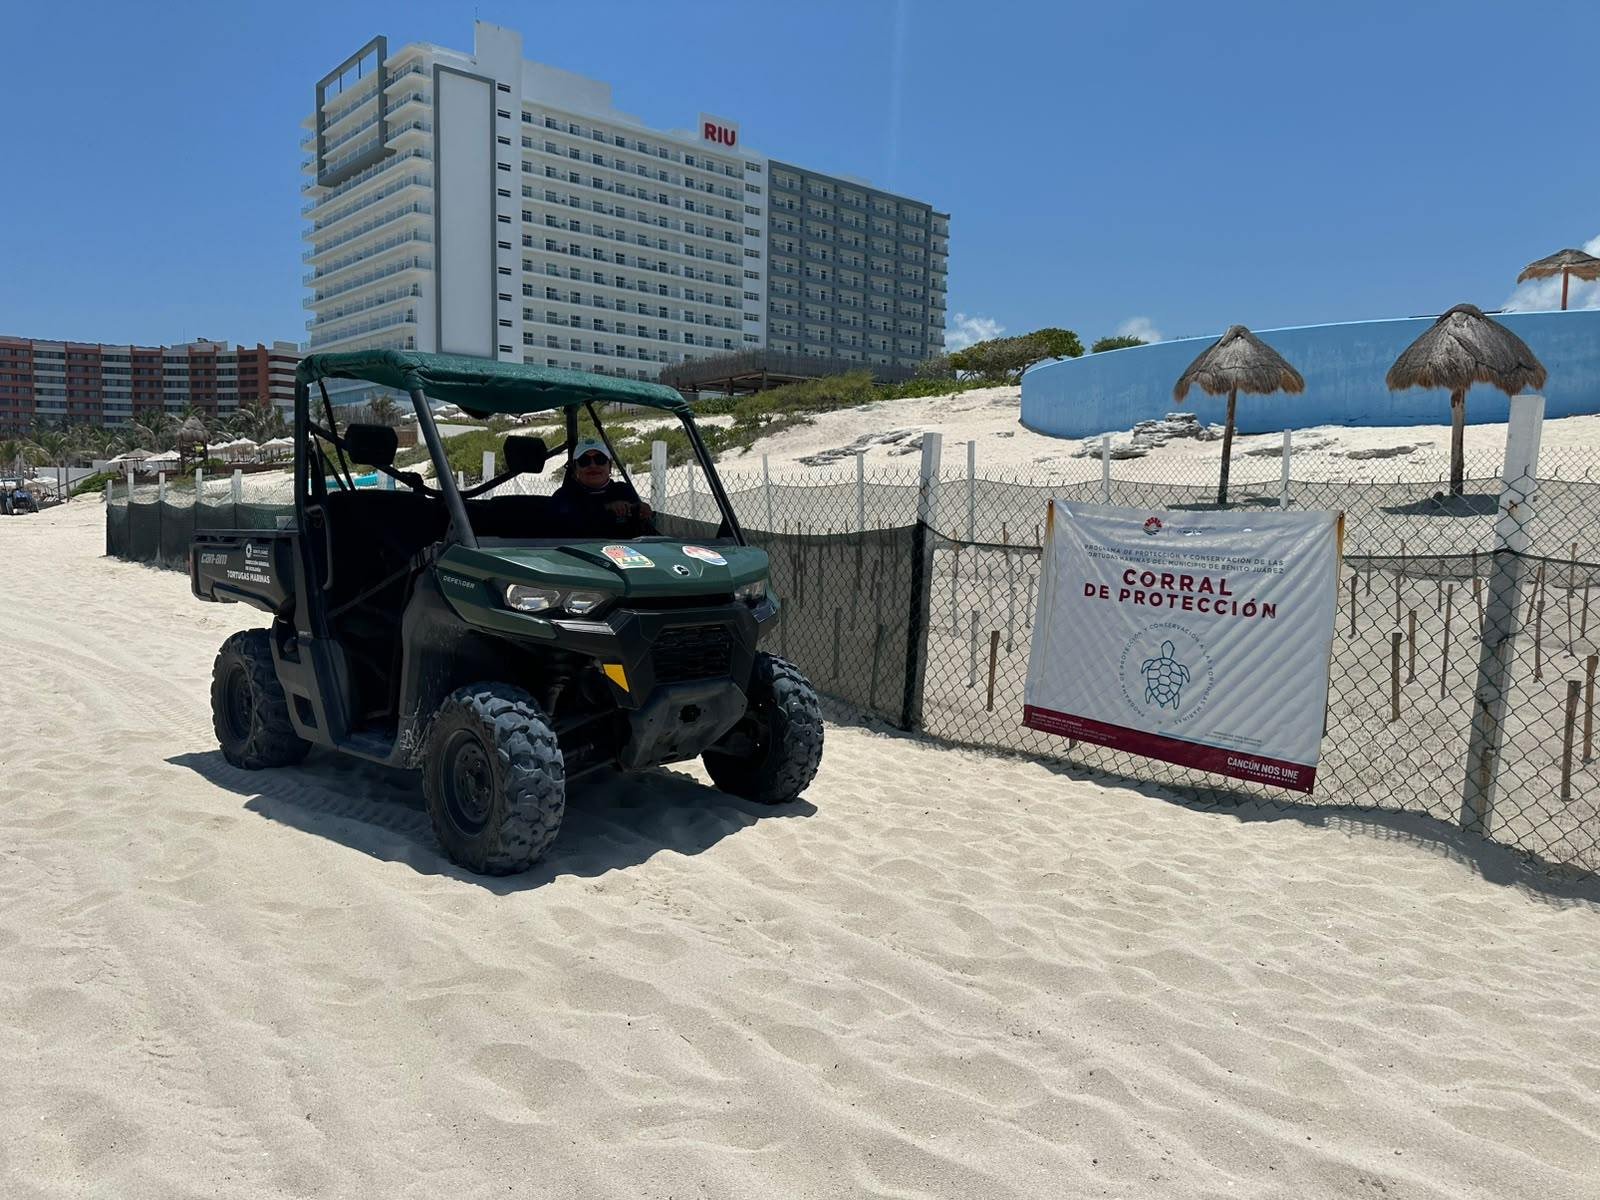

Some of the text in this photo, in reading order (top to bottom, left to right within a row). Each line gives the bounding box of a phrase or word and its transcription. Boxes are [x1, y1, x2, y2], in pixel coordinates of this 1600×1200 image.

[705, 122, 736, 146] RIU
[1087, 551, 1118, 560] ORTUGAS
[1168, 560, 1207, 569] MUNICIPIO
[1221, 564, 1250, 572] BENITO
[1190, 554, 1251, 564] CONSERVACIÓN
[226, 569, 271, 584] TORTUGAS MARINAS
[1122, 568, 1233, 596] CORRAL
[1084, 582, 1277, 619] DE PROTECCIÓN
[1227, 756, 1300, 780] CANCÚN NOS UNE
